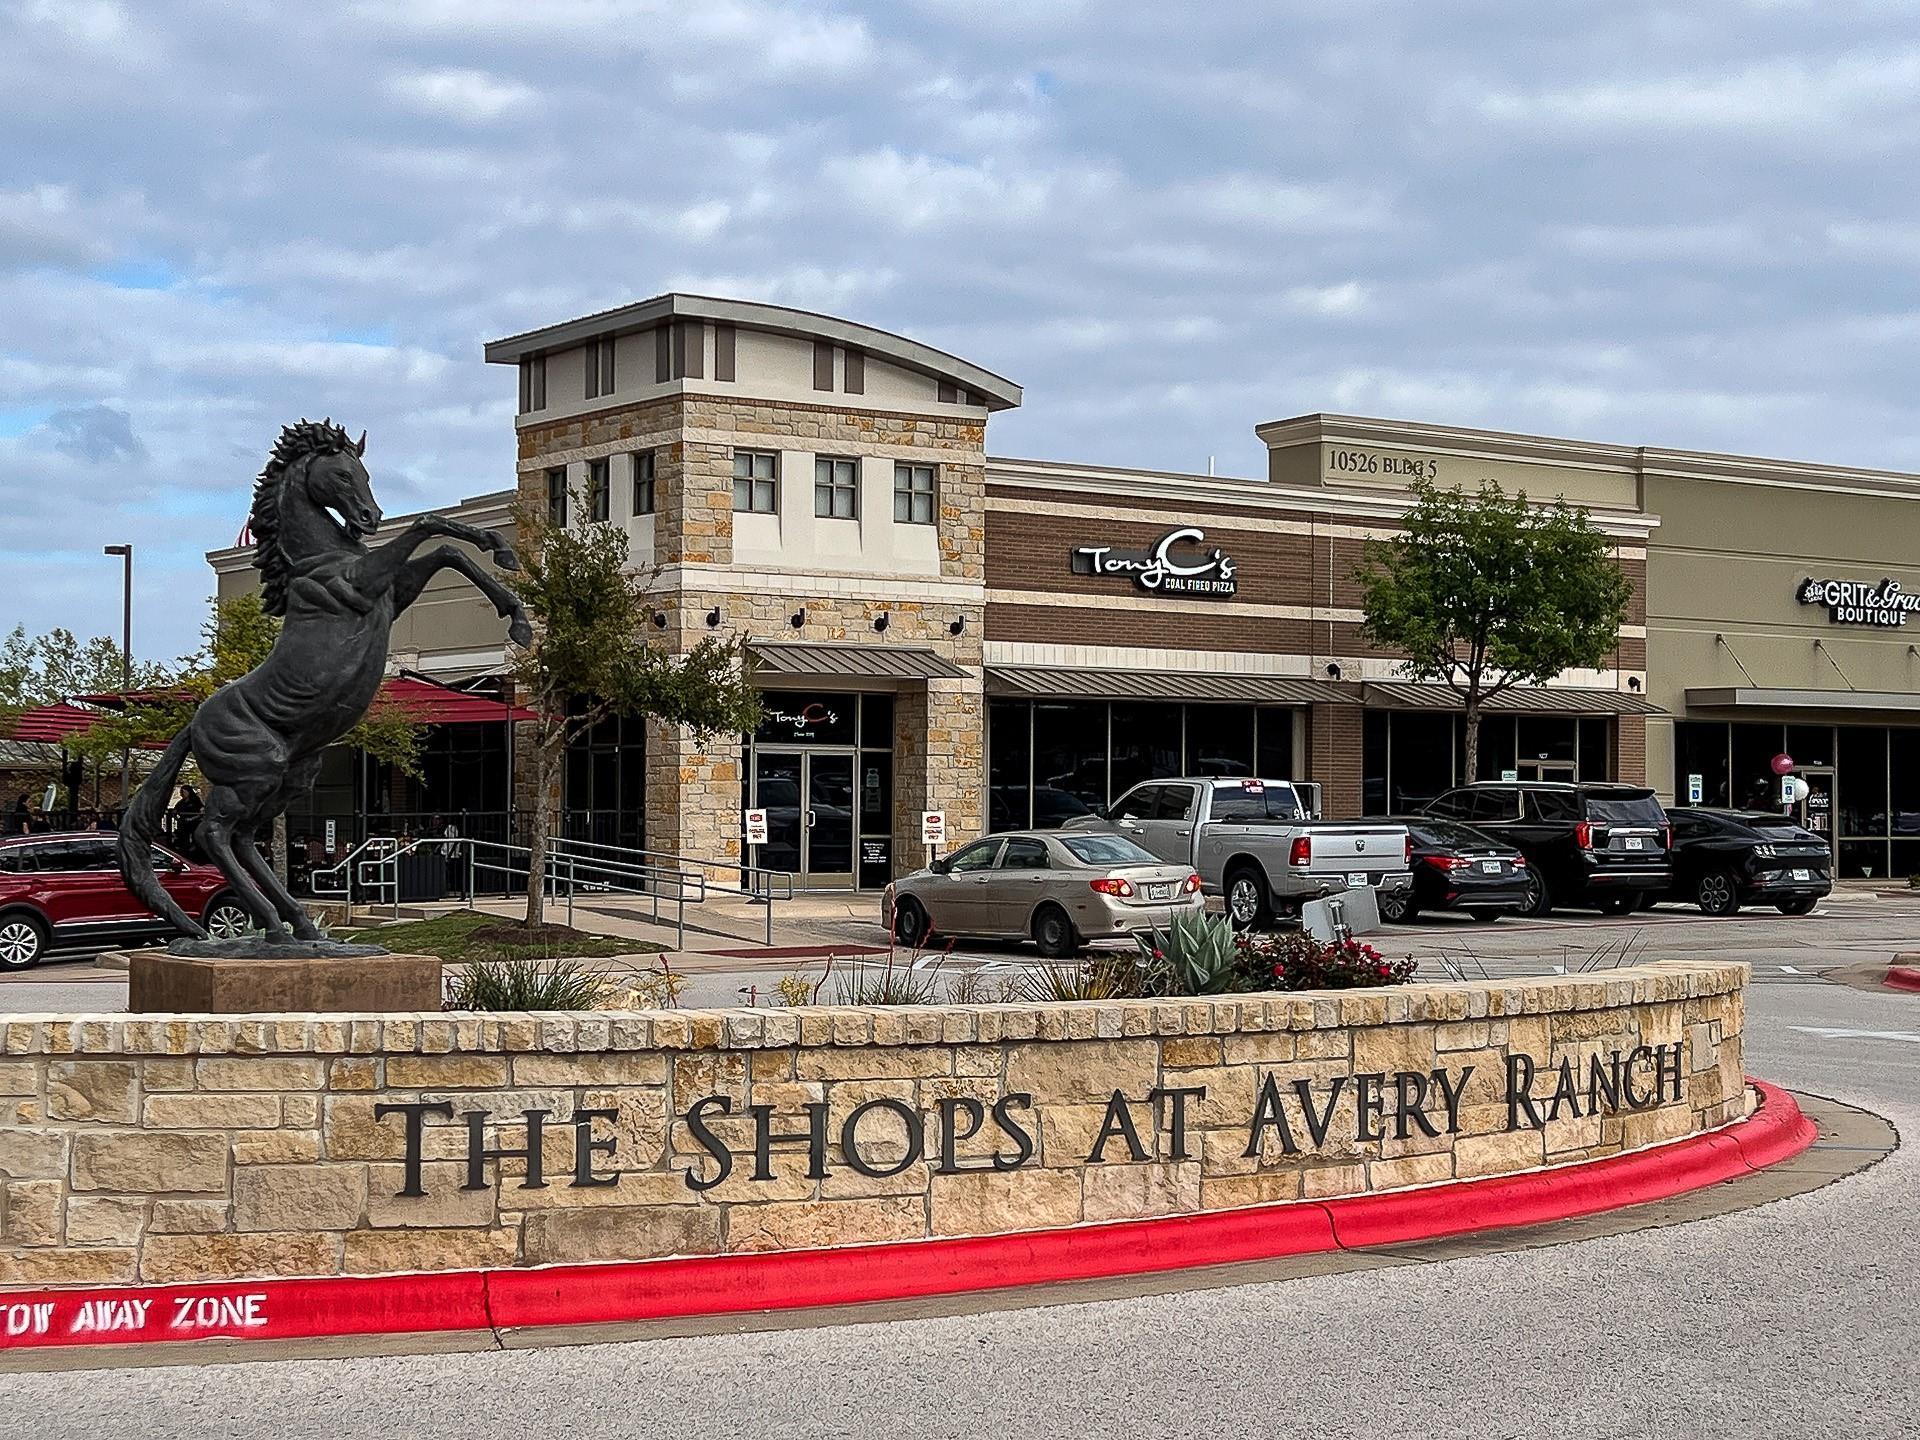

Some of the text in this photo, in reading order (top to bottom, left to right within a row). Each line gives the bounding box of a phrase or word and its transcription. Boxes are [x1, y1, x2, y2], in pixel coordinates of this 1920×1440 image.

[1330, 450, 1437, 479] 10526 BLDG 5
[1079, 547, 1169, 588] Tony
[1165, 578, 1235, 593] COAL FIRED PIZZA
[1825, 581, 1867, 606] GRIT
[1838, 607, 1906, 624] BOUTIQUE
[770, 711, 808, 728] Tony
[375, 1042, 1684, 1197] THE SHOPS AT AVERY RANCH
[0, 1295, 267, 1336] OW AWAY ZONE
